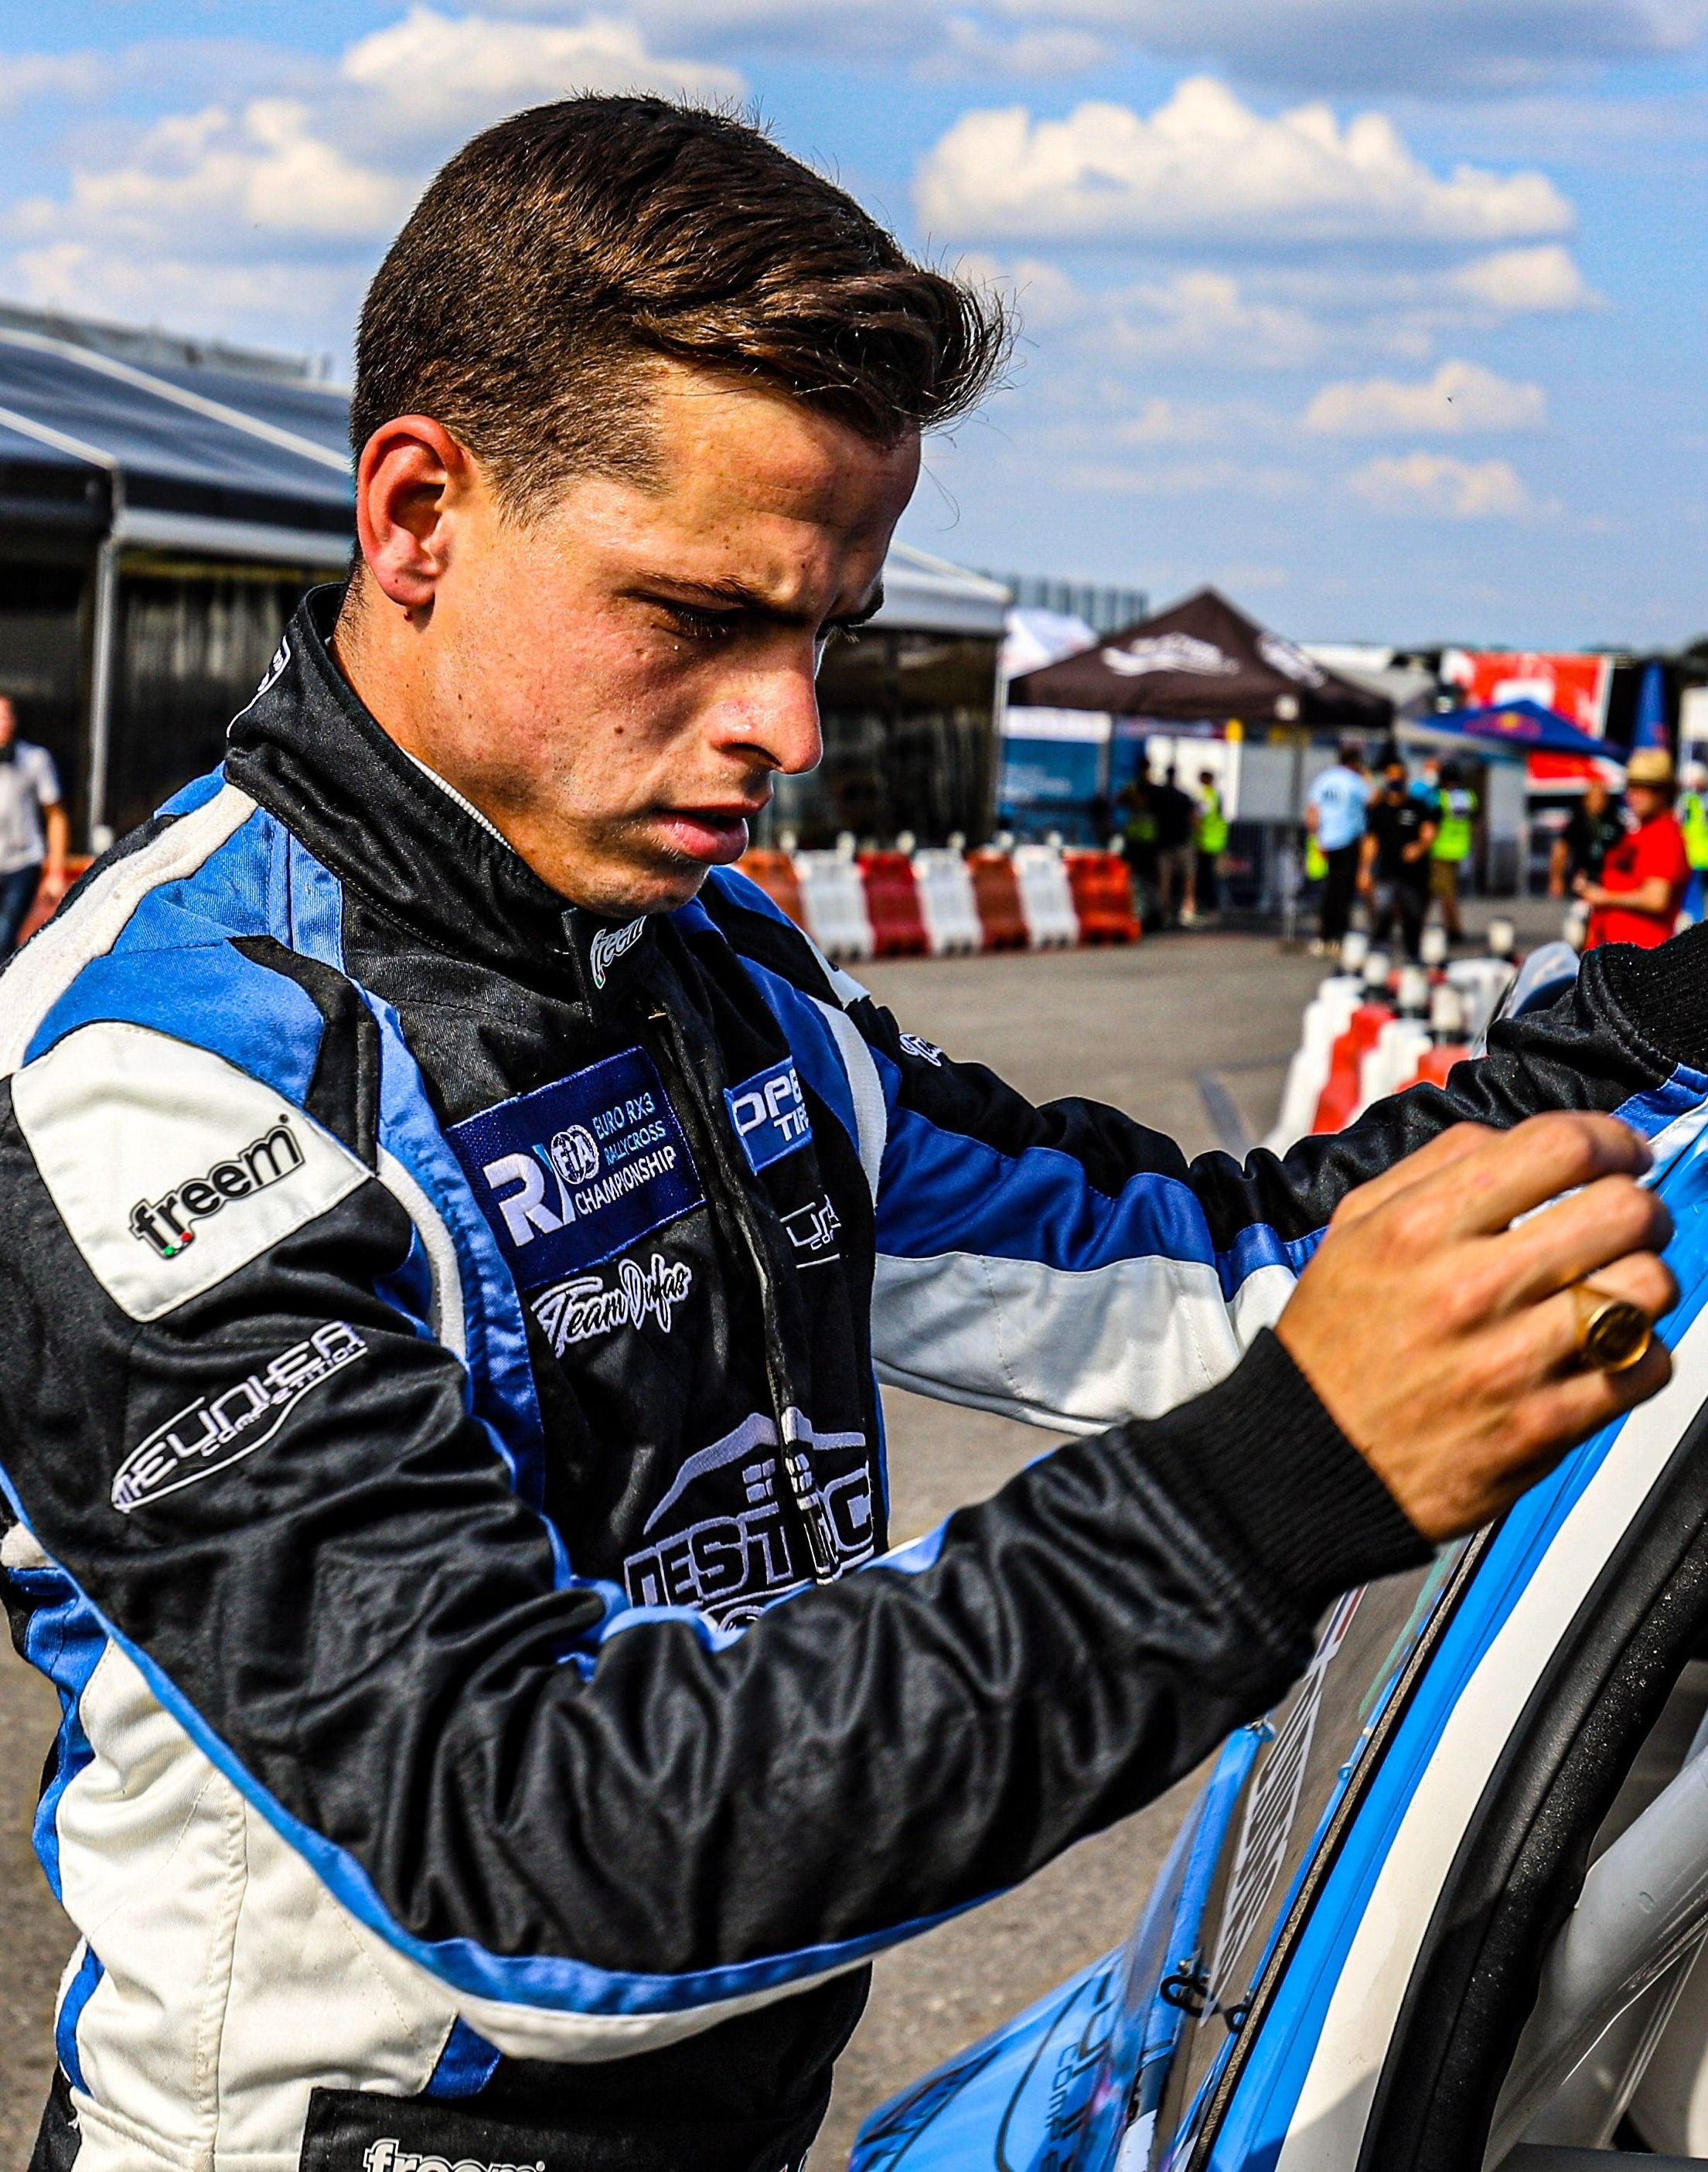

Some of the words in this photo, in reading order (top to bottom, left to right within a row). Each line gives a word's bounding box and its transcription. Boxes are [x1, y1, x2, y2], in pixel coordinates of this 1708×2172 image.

[592, 1106, 626, 1140] EURO
[626, 1092, 656, 1124] RX3
[604, 1120, 666, 1166] RALLYCROSS
[130, 1125, 305, 1259] freem
[574, 1145, 677, 1216] CHAMPIONSHIP
